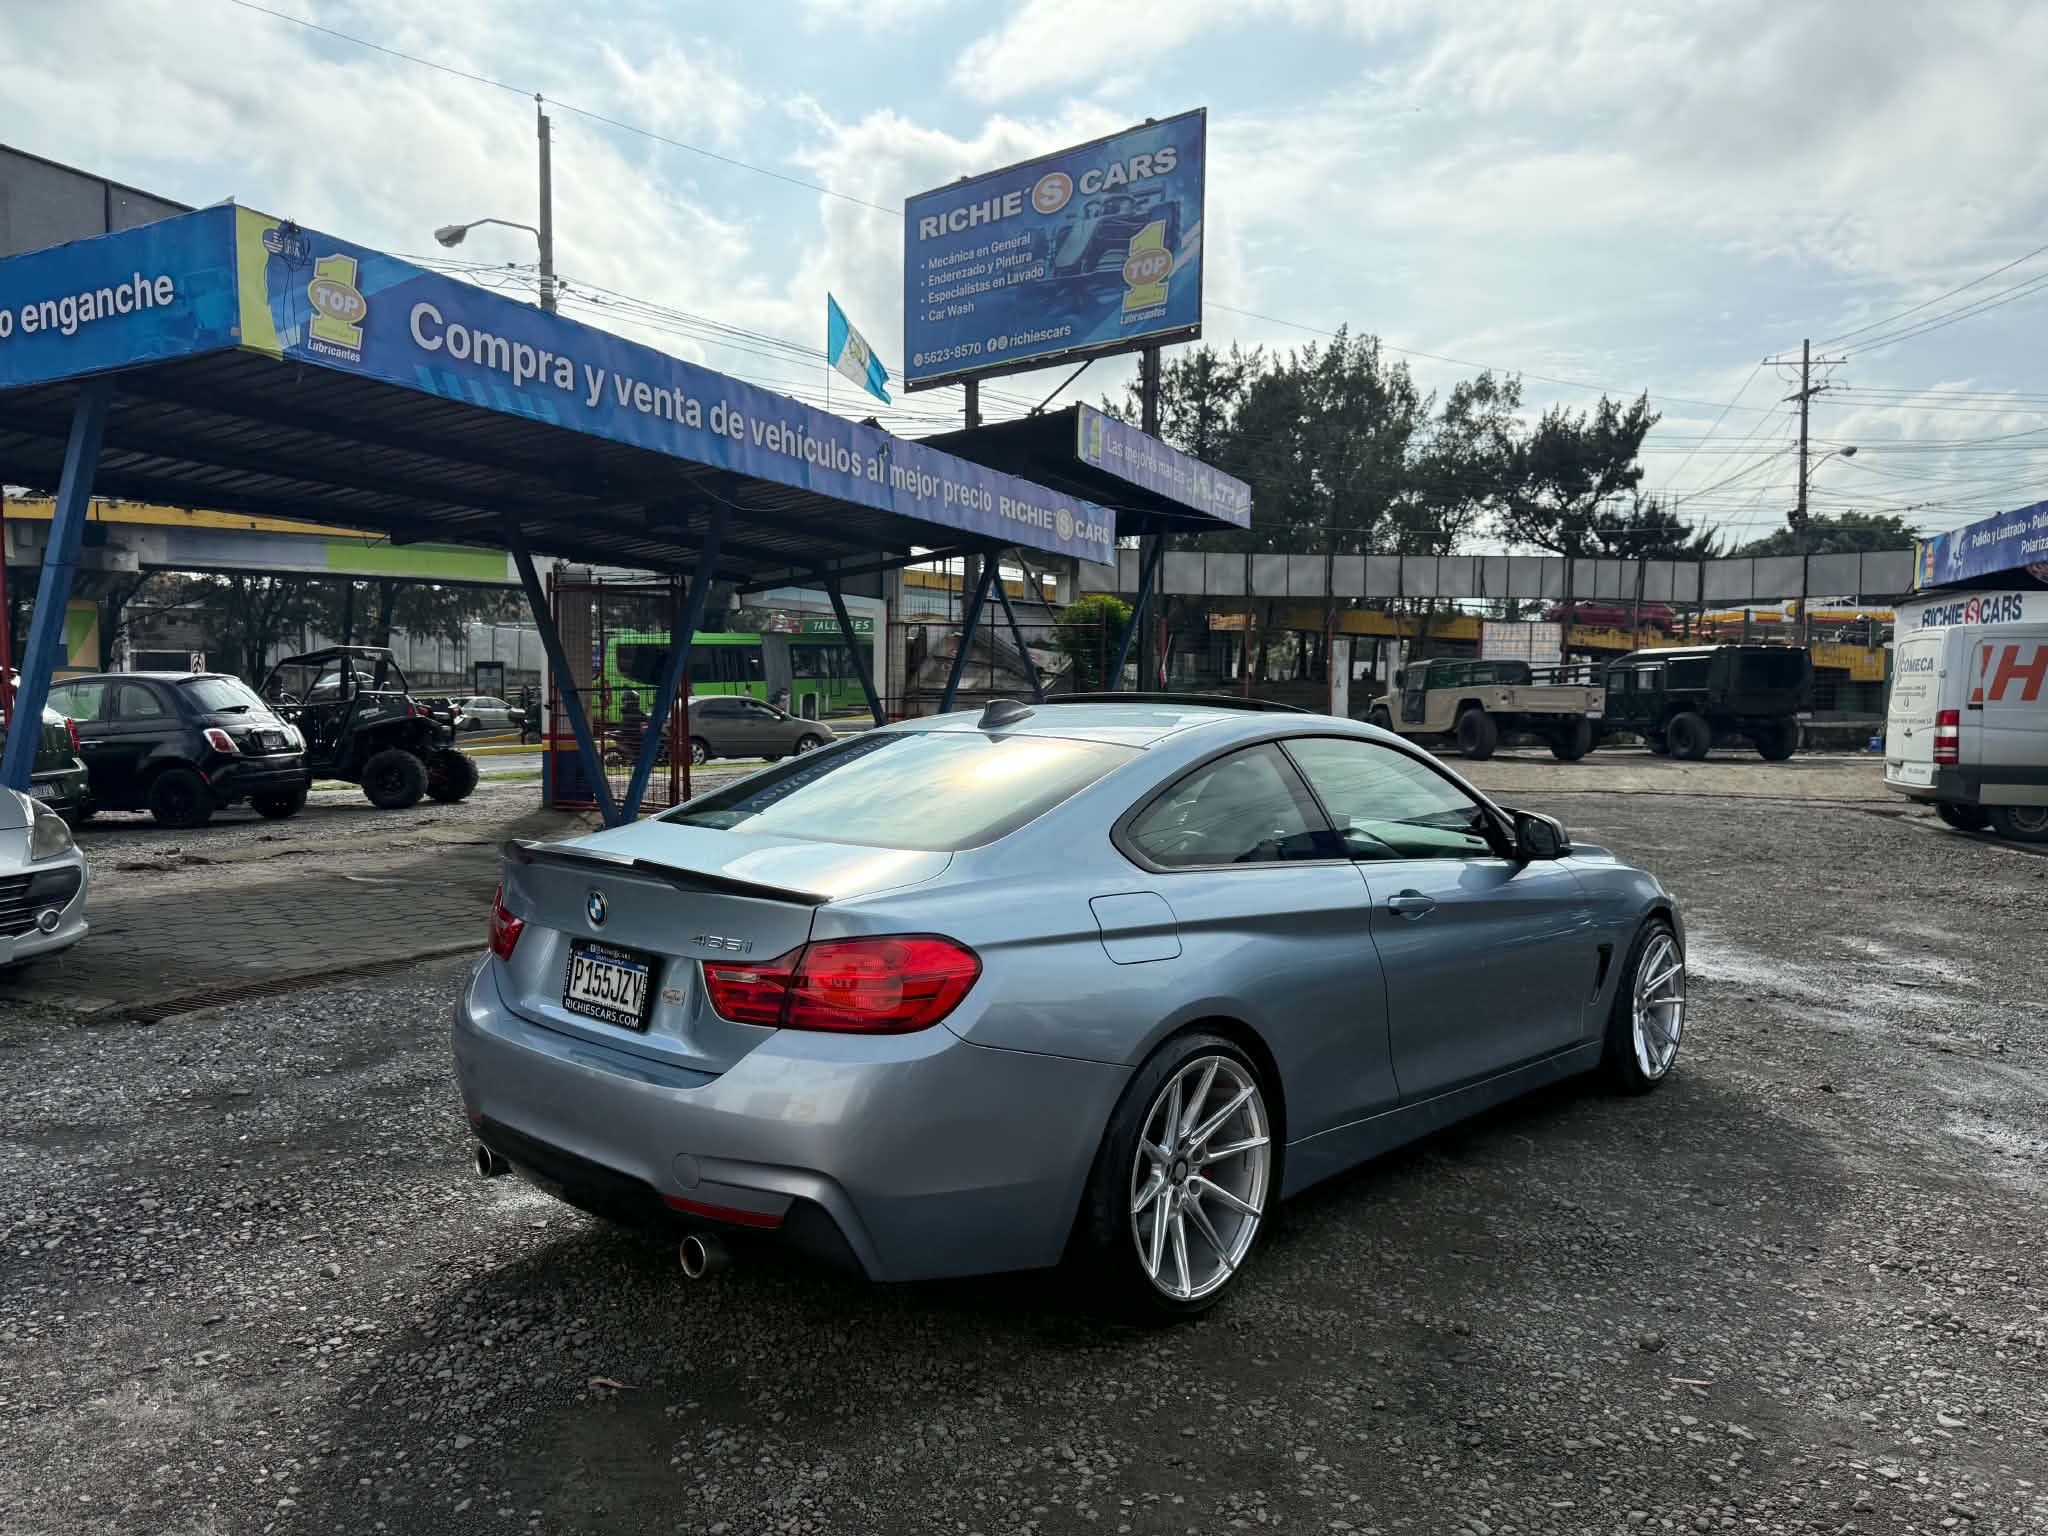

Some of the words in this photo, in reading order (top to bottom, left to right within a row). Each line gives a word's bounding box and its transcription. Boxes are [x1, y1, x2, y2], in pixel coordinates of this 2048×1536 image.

[1079, 147, 1177, 195] CARS
[929, 249, 974, 269] Mecánica
[976, 246, 989, 257] en
[991, 232, 1031, 253] General
[929, 264, 986, 286] Enderezado
[987, 262, 994, 274] y
[996, 252, 1032, 269] Pintura
[1130, 256, 1167, 278] TOP
[315, 287, 359, 313] TOP
[929, 281, 991, 304] Especialistas
[993, 277, 1005, 288] en
[1008, 266, 1044, 285] Lavado
[21, 272, 174, 336] enganche
[929, 310, 945, 321] Car
[947, 302, 975, 317] Wash
[308, 338, 361, 362] Lubricantes
[923, 342, 981, 364] 5623-8570
[1009, 325, 1072, 347] richiescars
[410, 302, 574, 391] Compra
[584, 364, 605, 408] y
[614, 373, 702, 429] venta
[709, 401, 744, 440] de
[751, 417, 861, 483] vehículos
[867, 452, 885, 484] al
[890, 463, 940, 501] mejor
[944, 480, 992, 512] precio
[1075, 520, 1110, 544] CARS
[1107, 432, 1123, 457] Las
[1992, 531, 1997, 545] y
[1997, 520, 2026, 540] Lustrado
[1980, 593, 2023, 624] CARS
[813, 620, 870, 631] TALLES
[573, 958, 643, 1009] P155JZY
[565, 998, 639, 1029] RICHIESCARS.COM
